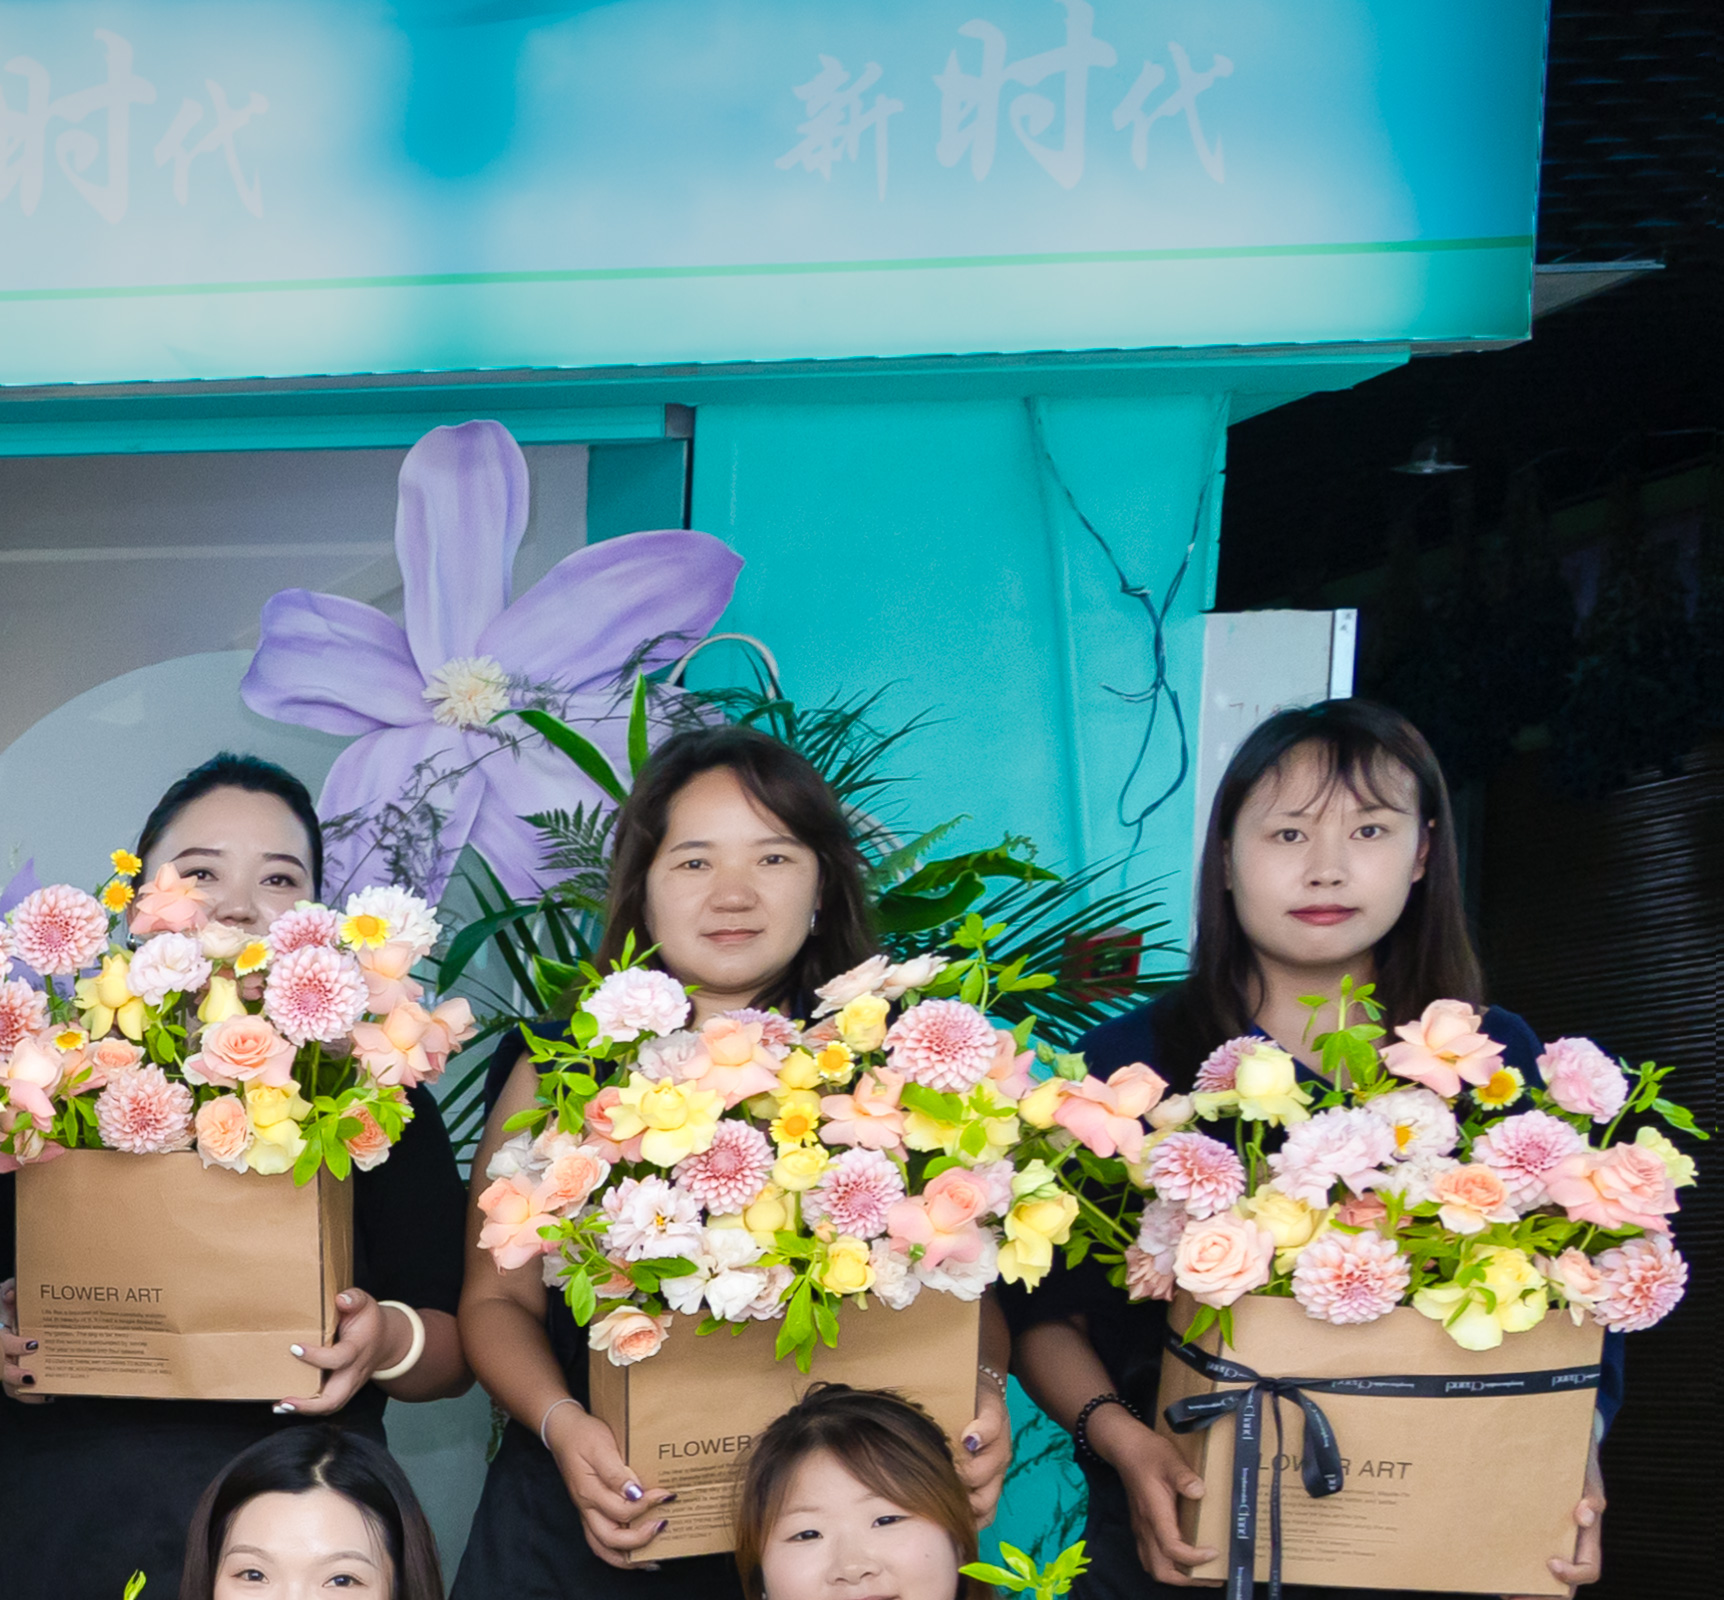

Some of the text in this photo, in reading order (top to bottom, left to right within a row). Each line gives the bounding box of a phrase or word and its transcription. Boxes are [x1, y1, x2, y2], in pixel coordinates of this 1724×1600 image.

[41, 1285, 162, 1302] FLOWER ART
[659, 1435, 751, 1459] FLOWER
[1358, 1460, 1412, 1479] ART
